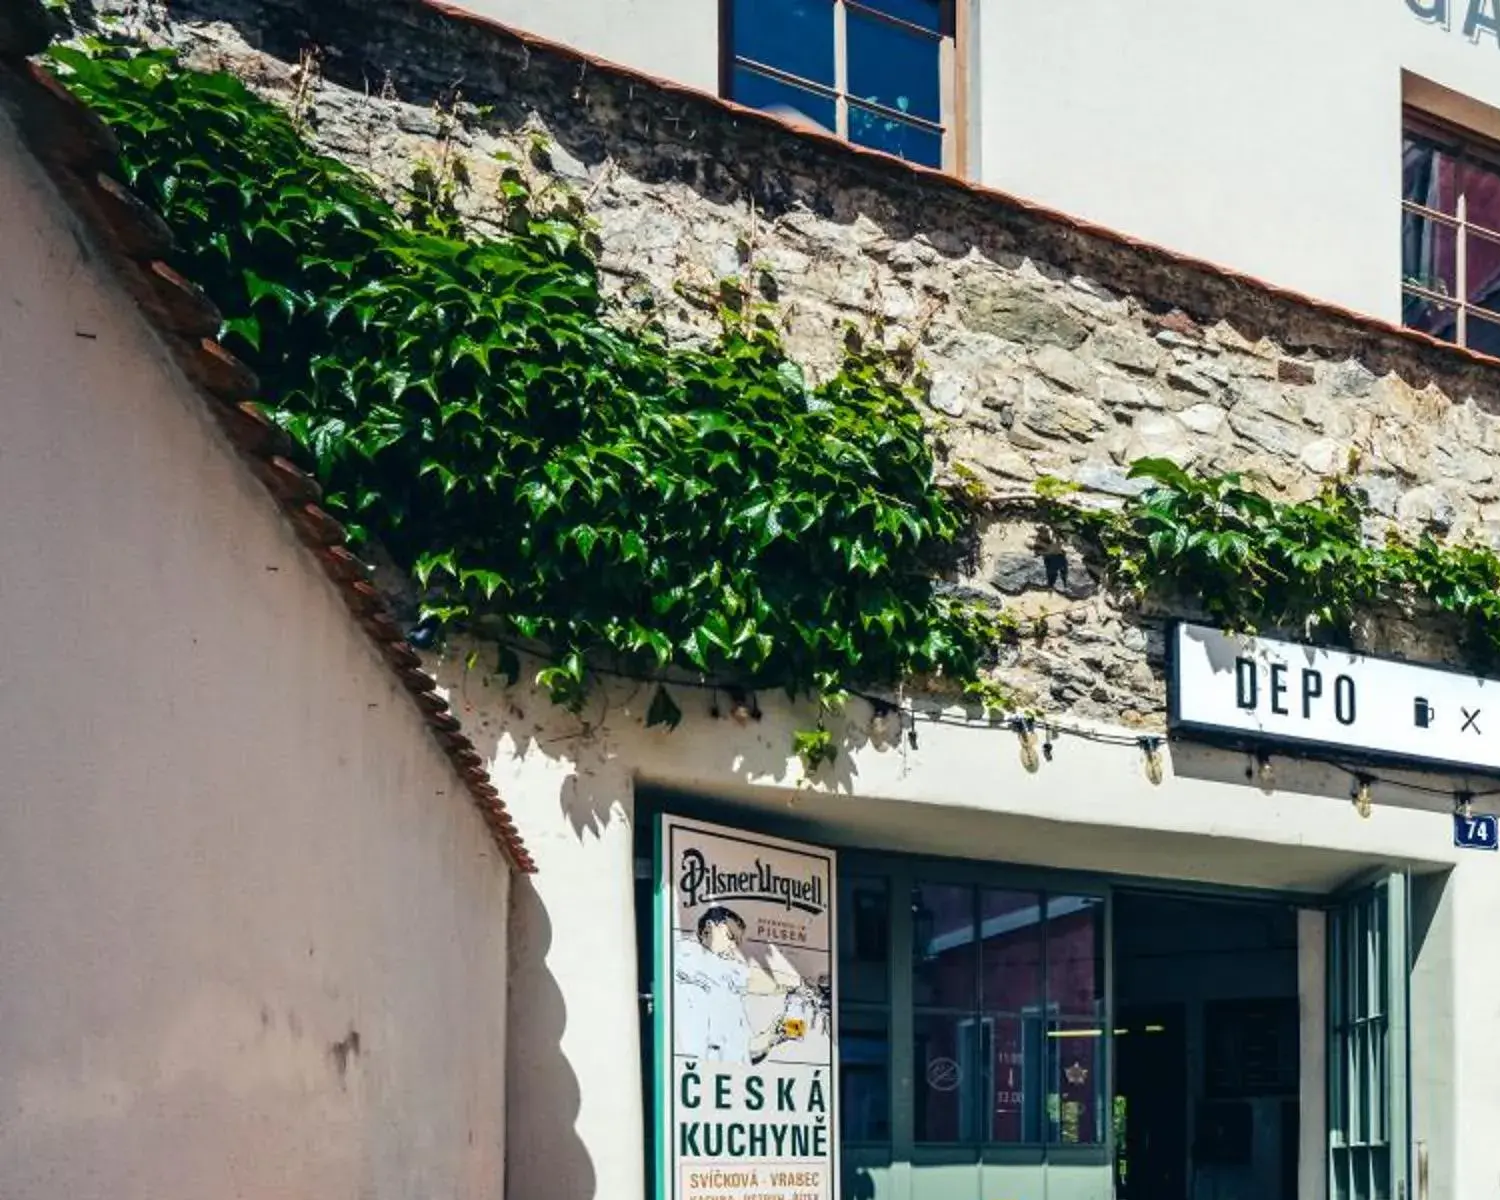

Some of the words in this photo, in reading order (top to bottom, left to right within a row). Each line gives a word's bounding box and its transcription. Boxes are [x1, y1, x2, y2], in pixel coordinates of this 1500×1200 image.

[1236, 656, 1356, 725] DEPO
[1465, 821, 1489, 841] 74
[680, 848, 758, 908] Pilsner
[755, 858, 822, 911] Urquell
[681, 1061, 826, 1113] ČESKÁ
[680, 1115, 827, 1157] KUCHYNĚ
[689, 1169, 759, 1189] SVÍČKOVÁ
[770, 1171, 819, 1187] VRABEC
